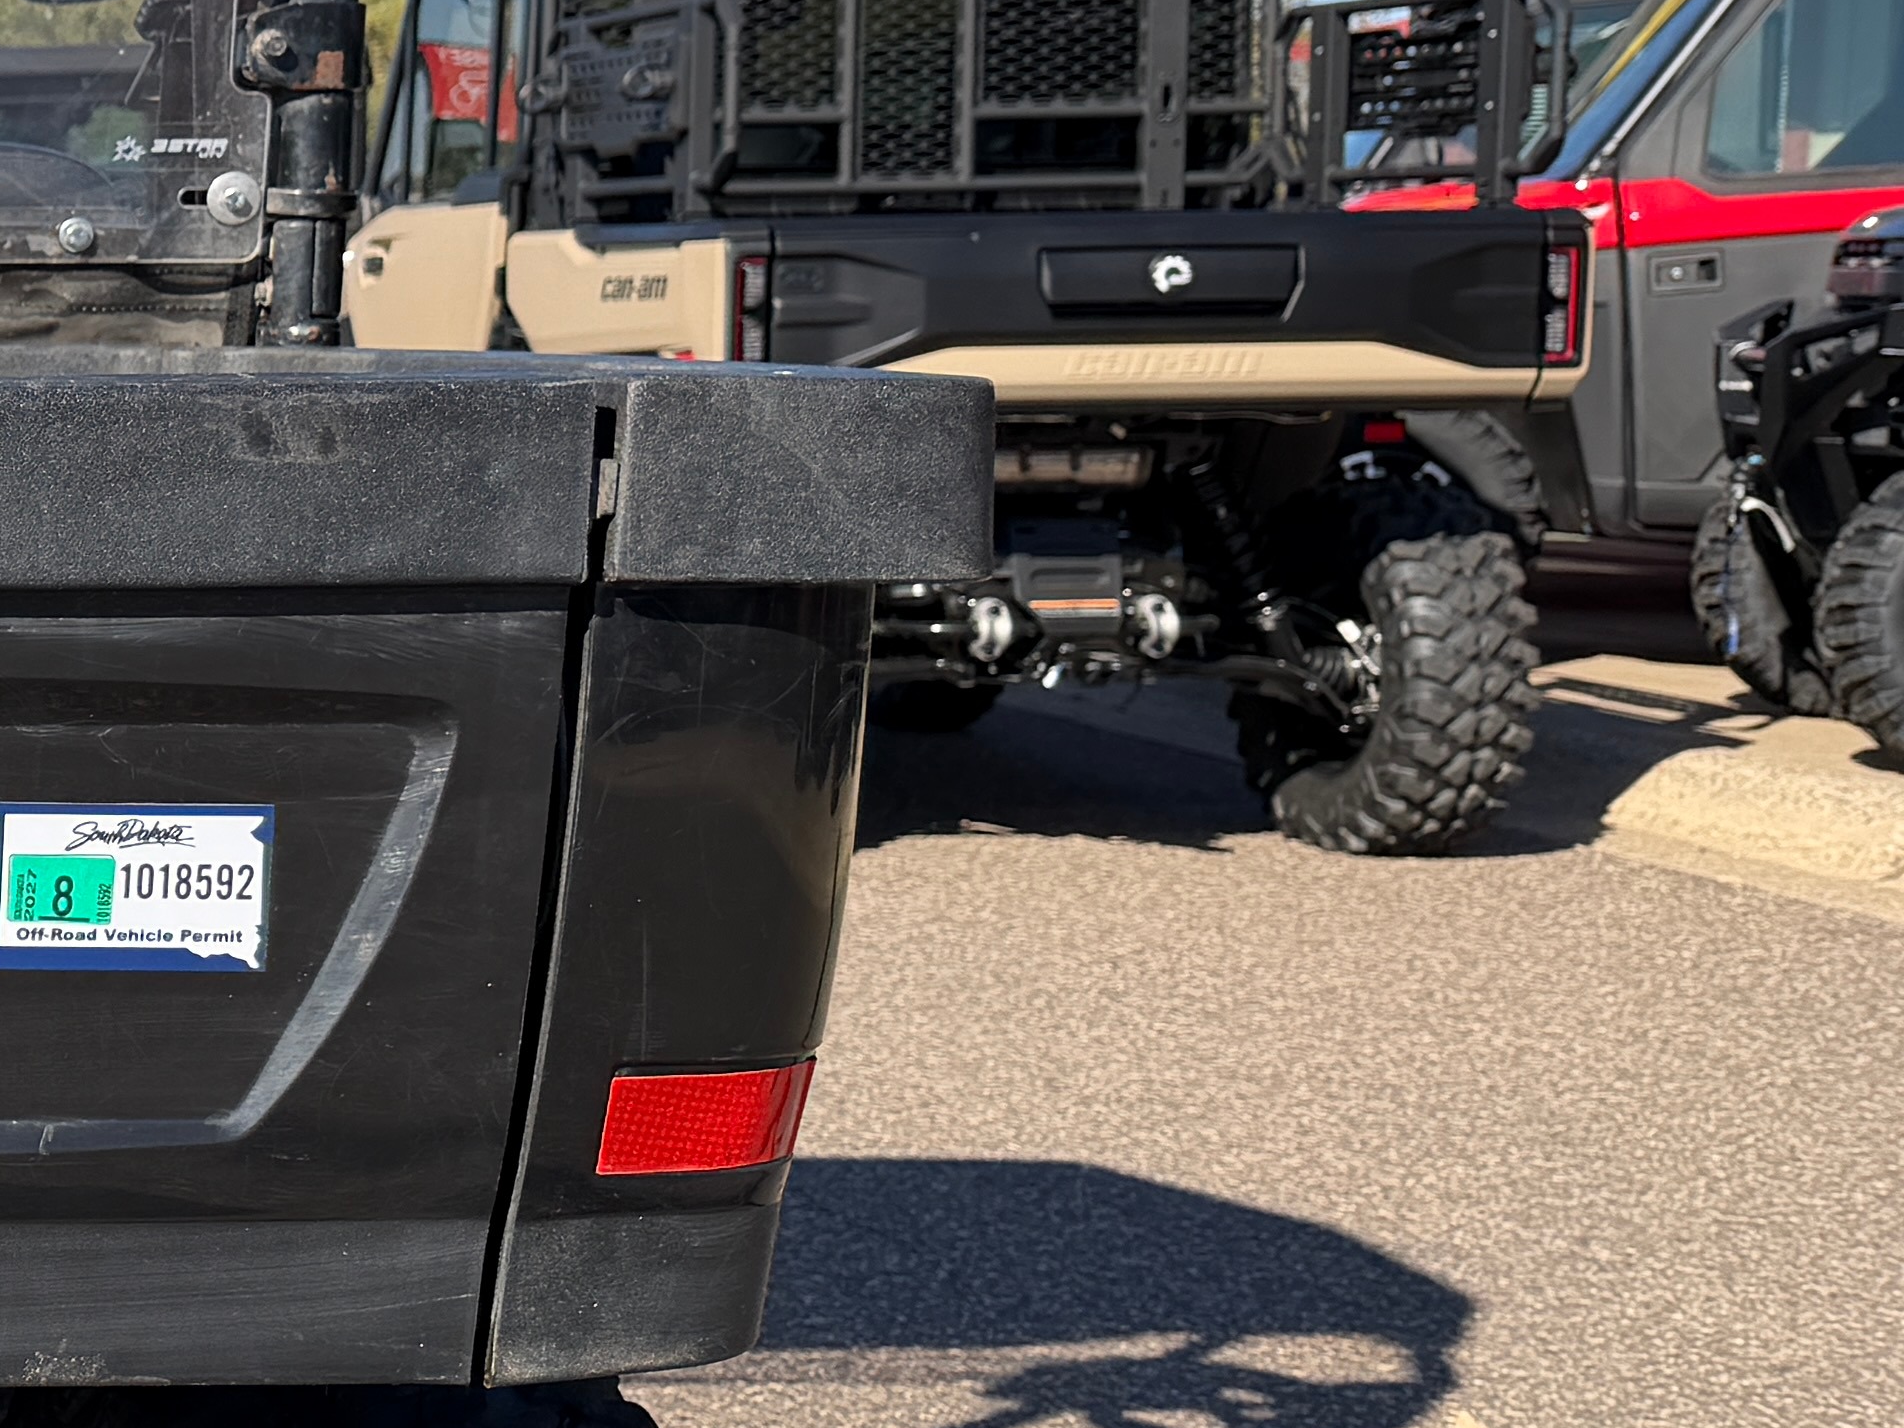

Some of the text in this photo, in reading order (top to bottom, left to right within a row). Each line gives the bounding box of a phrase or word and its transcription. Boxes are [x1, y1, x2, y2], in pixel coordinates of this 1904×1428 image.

[23, 868, 38, 922] 2027
[52, 874, 74, 918] 8
[120, 862, 255, 901] 1018592
[16, 927, 244, 945] Off-Road Vehicle Permit
